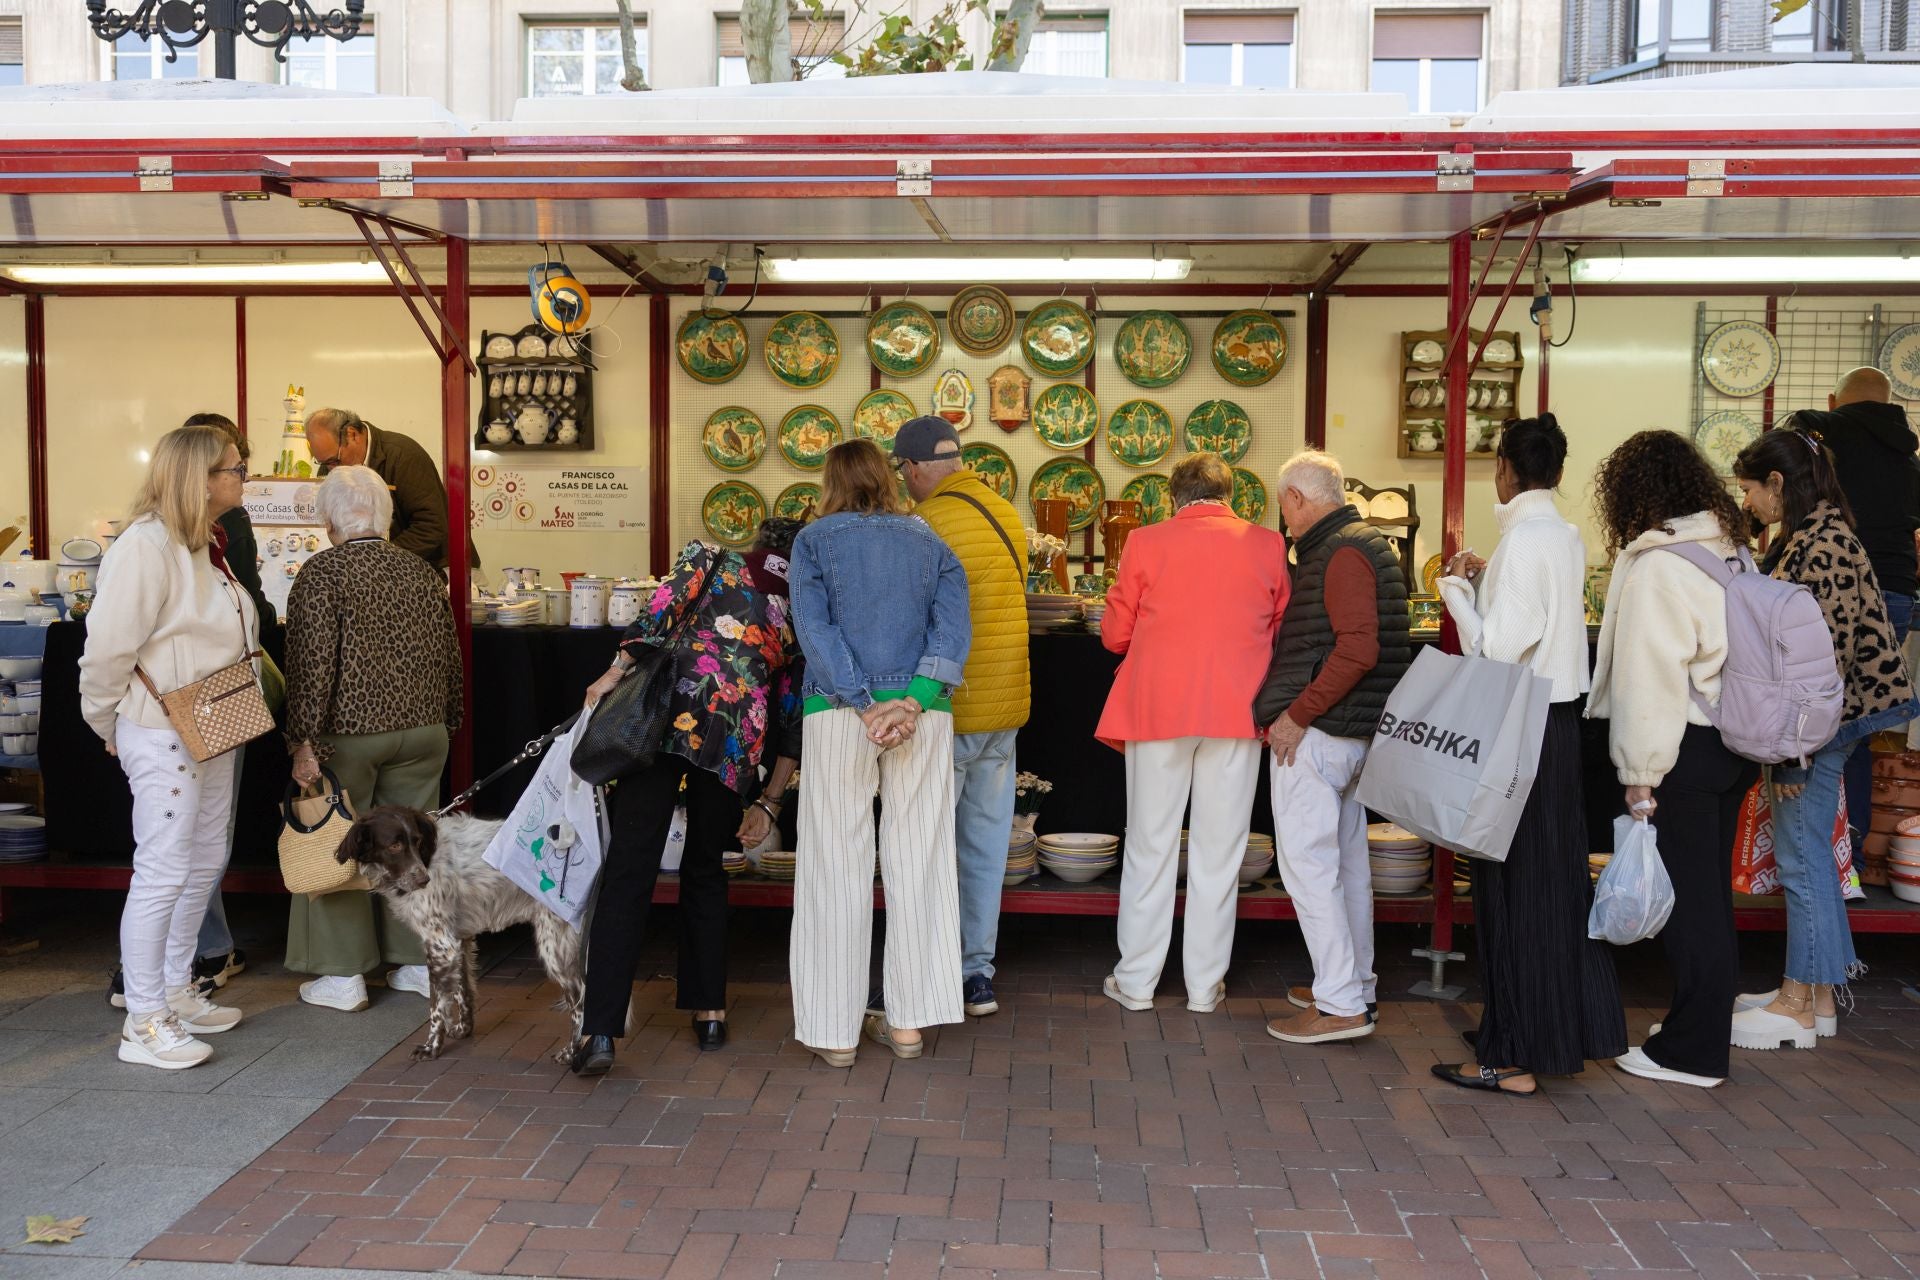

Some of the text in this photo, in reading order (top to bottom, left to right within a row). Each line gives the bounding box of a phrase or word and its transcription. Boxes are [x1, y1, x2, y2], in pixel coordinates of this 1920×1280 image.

[562, 471, 615, 480] FRANCISCO
[548, 482, 628, 490] CASAS DE LA CAL
[266, 502, 291, 513] Casas
[294, 504, 305, 513] de
[307, 503, 315, 513] la
[554, 505, 574, 520] SAN
[541, 520, 575, 528] MATEO
[1377, 711, 1480, 764] BERSHKA
